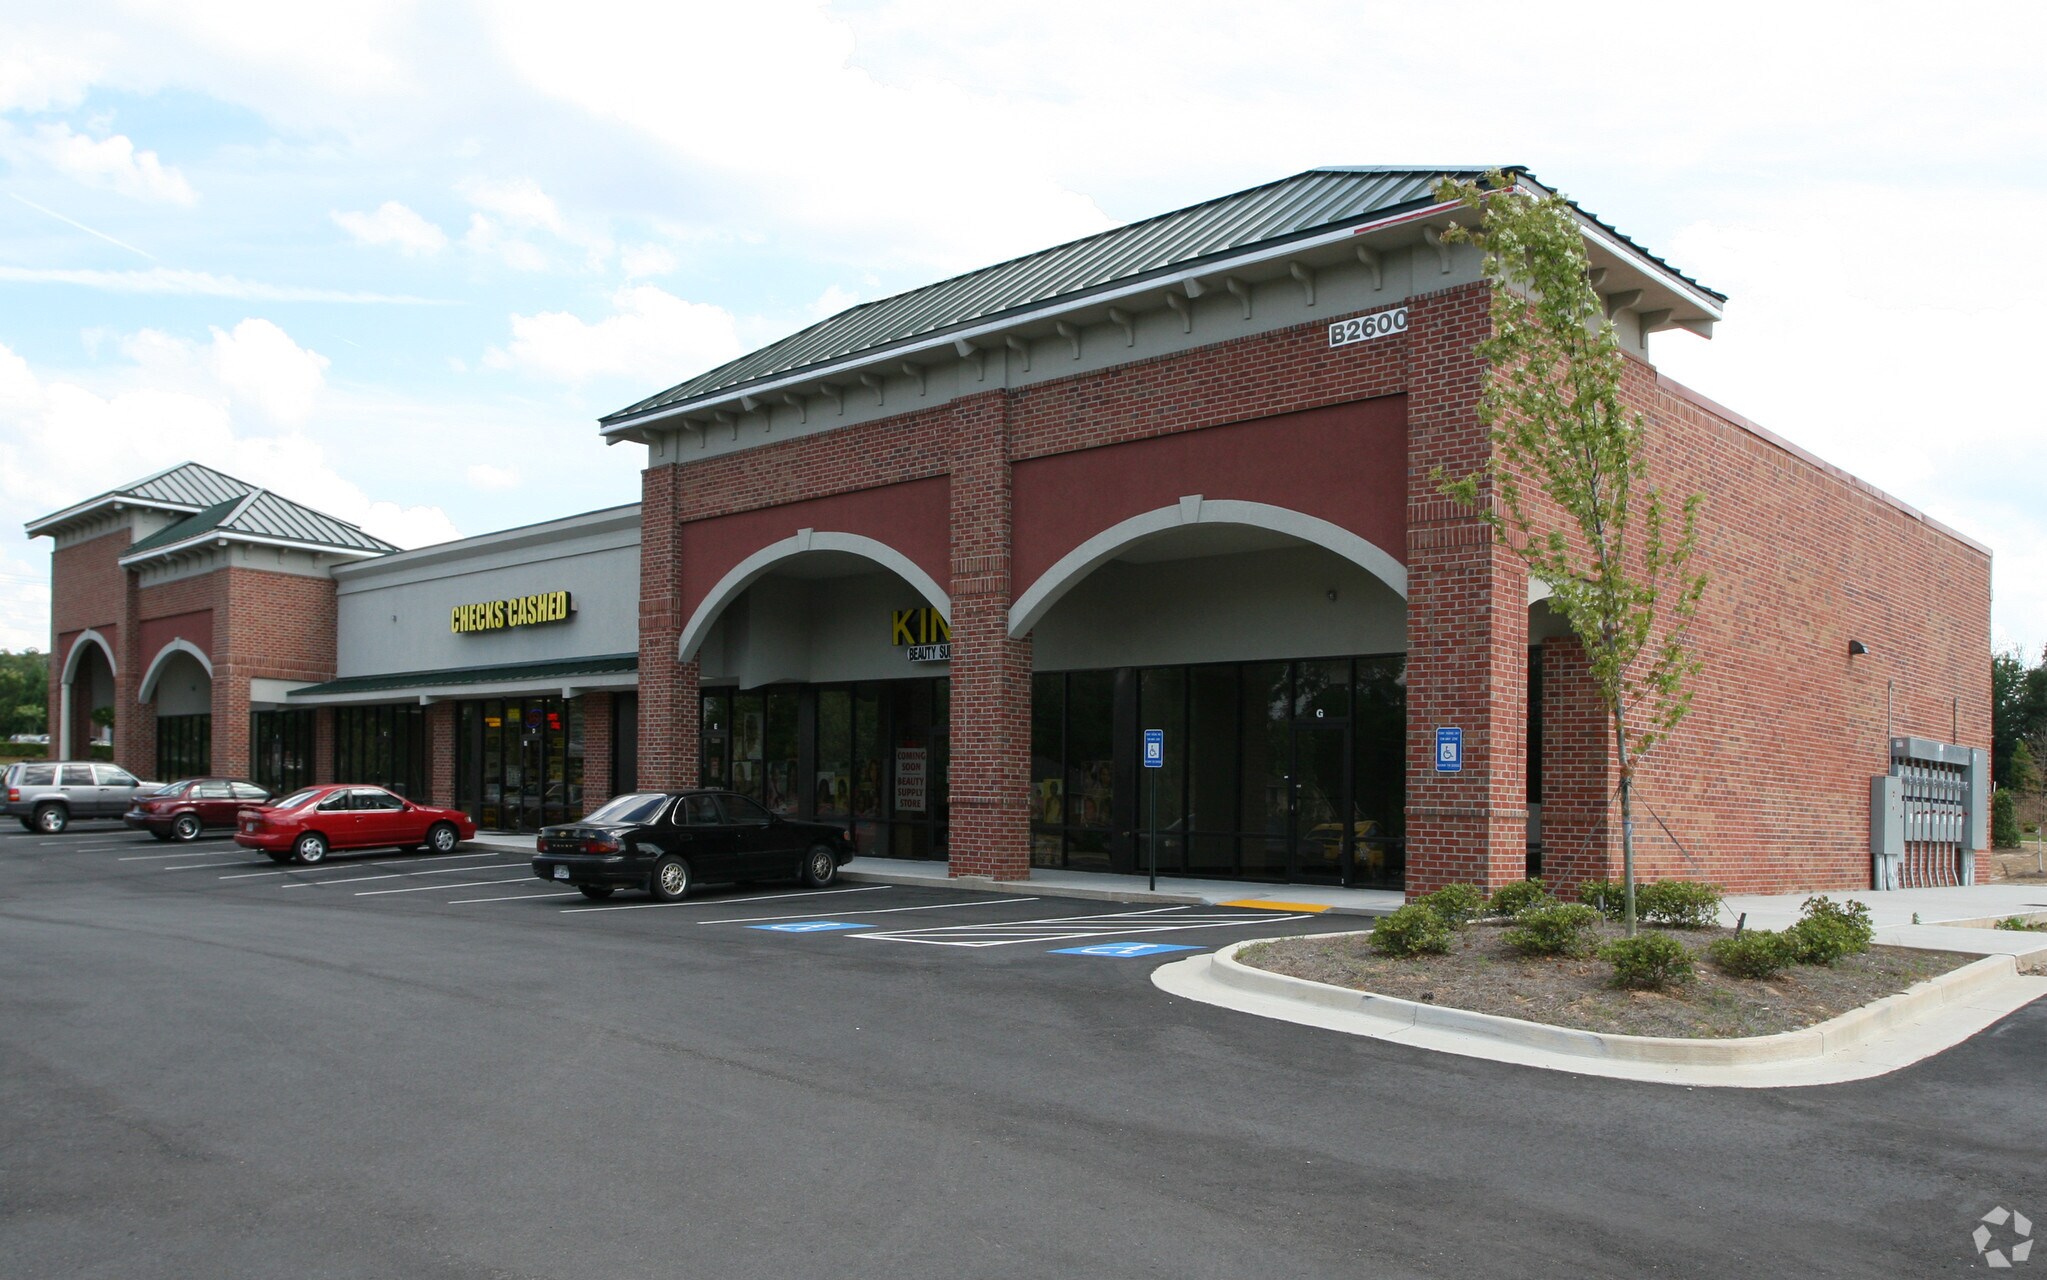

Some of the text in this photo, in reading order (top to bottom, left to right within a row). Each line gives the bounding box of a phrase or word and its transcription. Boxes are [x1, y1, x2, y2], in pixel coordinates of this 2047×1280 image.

[1330, 309, 1408, 345] B2600
[451, 591, 567, 633] CHECKS CASHED
[909, 646, 936, 660] BEAUTY
[1316, 708, 1324, 718] G
[897, 751, 926, 760] COMING
[902, 762, 921, 771] SOON
[897, 777, 924, 786] BEAUTY
[897, 788, 924, 797] SUPPLY
[900, 798, 921, 808] STORE
